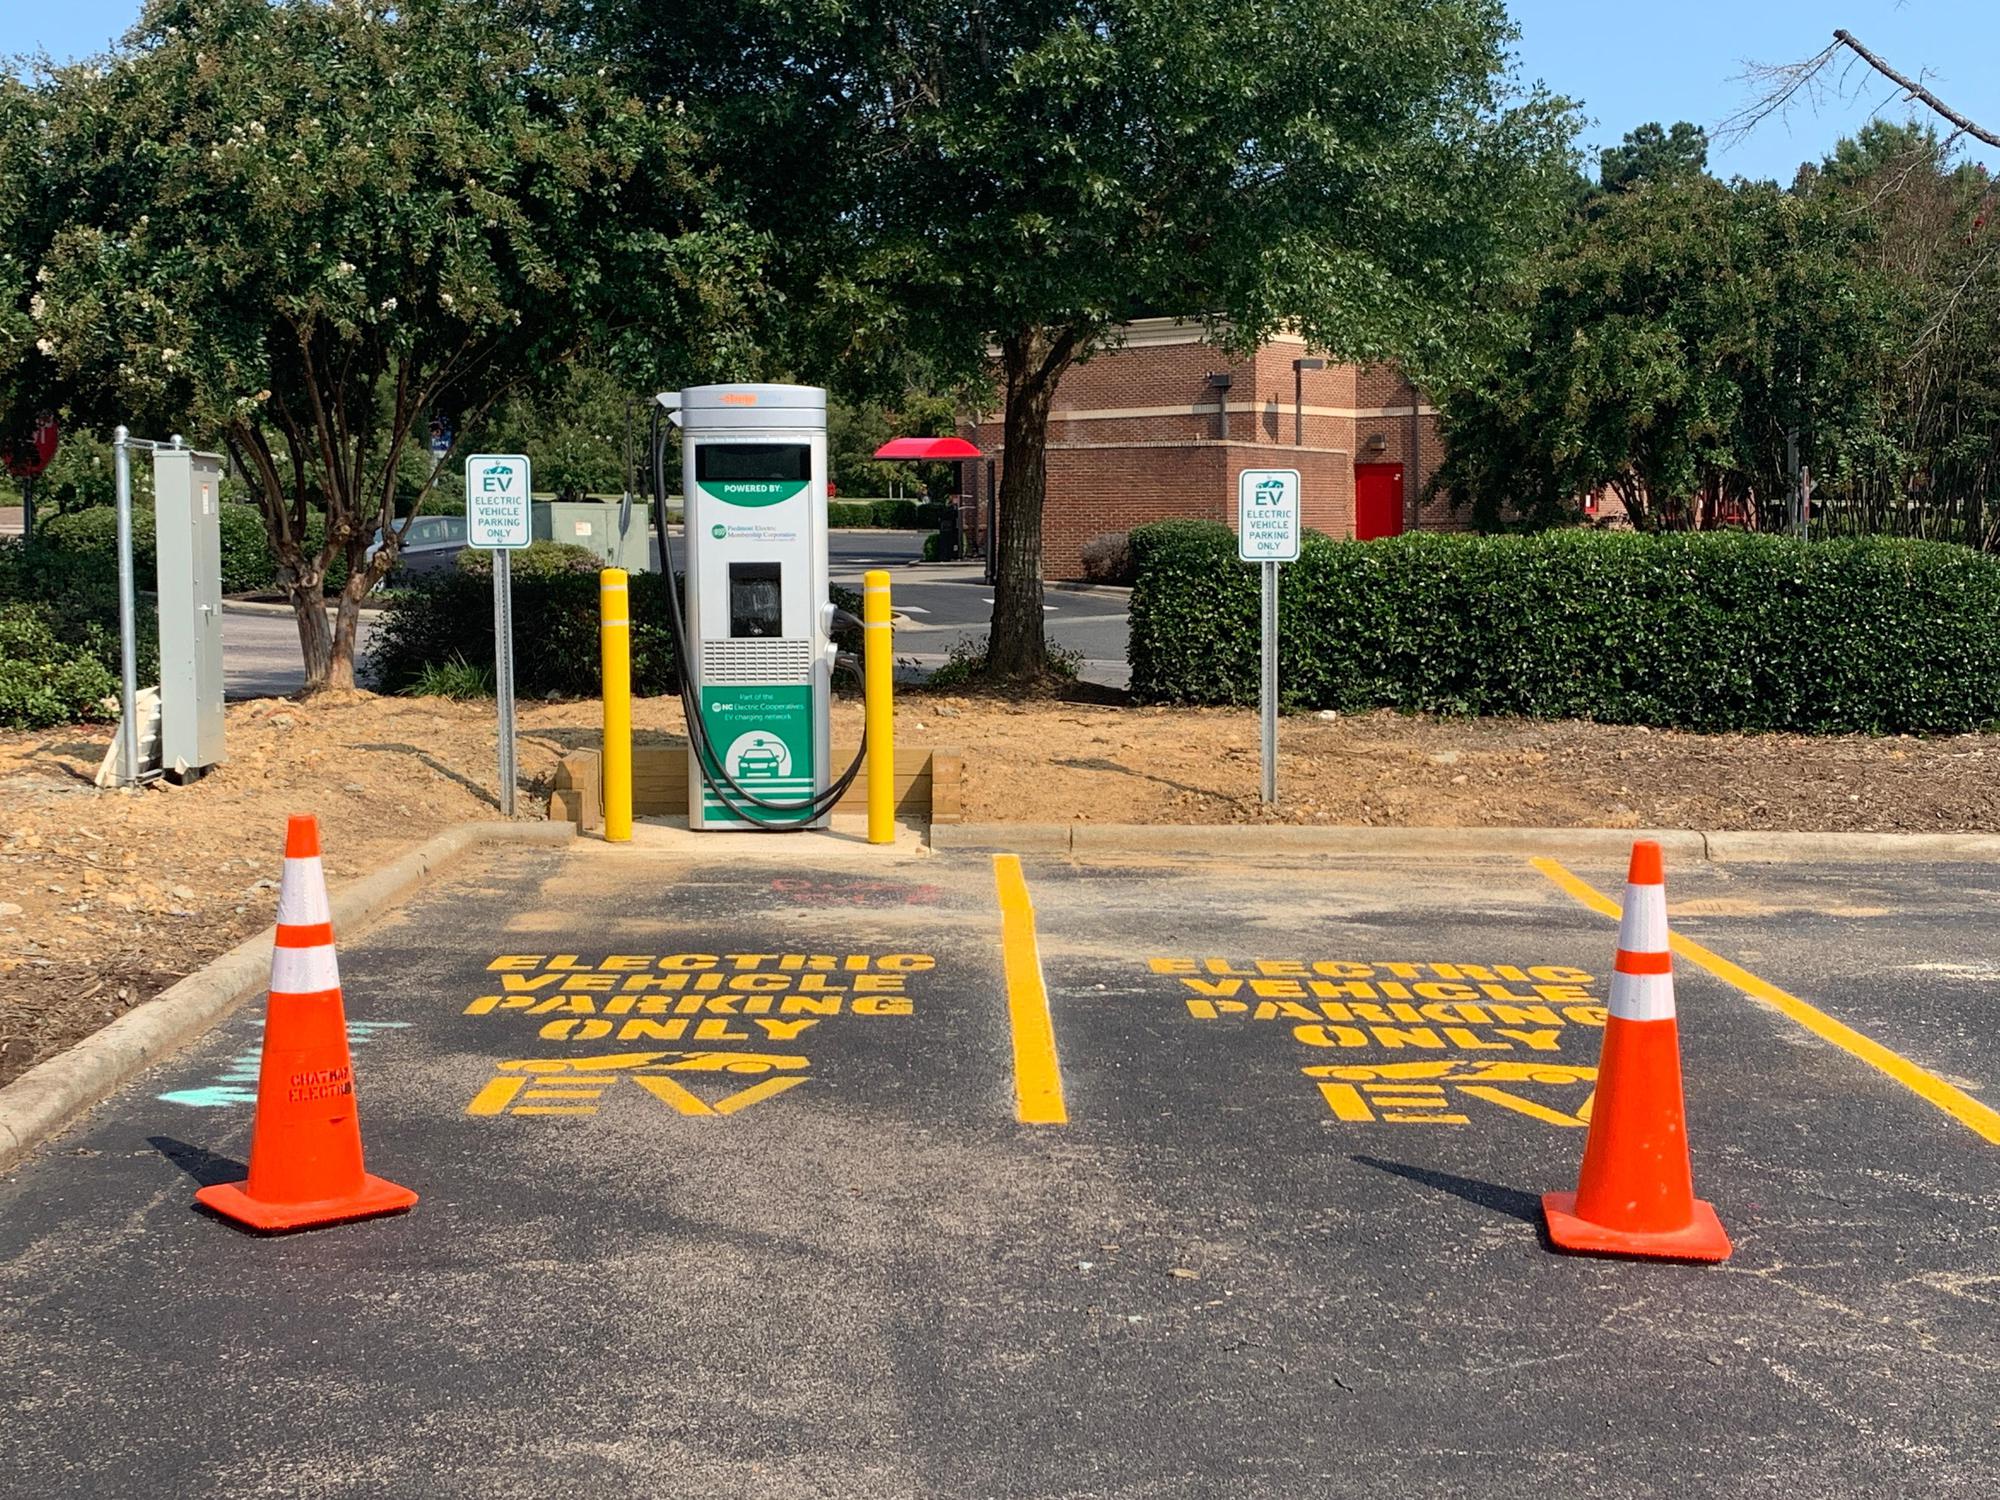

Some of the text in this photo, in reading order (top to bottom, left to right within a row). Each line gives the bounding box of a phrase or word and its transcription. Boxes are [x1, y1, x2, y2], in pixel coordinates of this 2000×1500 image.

[483, 477, 513, 492] EV
[724, 484, 768, 493] POWERED
[475, 496, 522, 505] ELECTRIC
[1256, 491, 1284, 506] EV
[478, 507, 519, 516] VEHICLE
[1247, 510, 1292, 519] ELECTRIC
[478, 518, 520, 527] PARKING
[1250, 521, 1289, 529] VEHICLE
[487, 528, 512, 537] ONLY
[1249, 531, 1289, 540] PARKING
[1257, 541, 1281, 550] ONLY
[722, 703, 805, 712] NC Electric Cooperatives
[735, 714, 763, 722] charging
[486, 954, 936, 971] ELECTRIC
[1148, 957, 1595, 983] ELECTRIC
[501, 973, 906, 992] VEHICLE
[1179, 977, 1601, 1002] VEHICLE
[462, 995, 914, 1015] PARKING
[1186, 999, 1608, 1026] PARKING
[539, 1018, 821, 1041] ONLY
[1293, 1024, 1561, 1050] ONLY
[465, 1076, 811, 1116] EV
